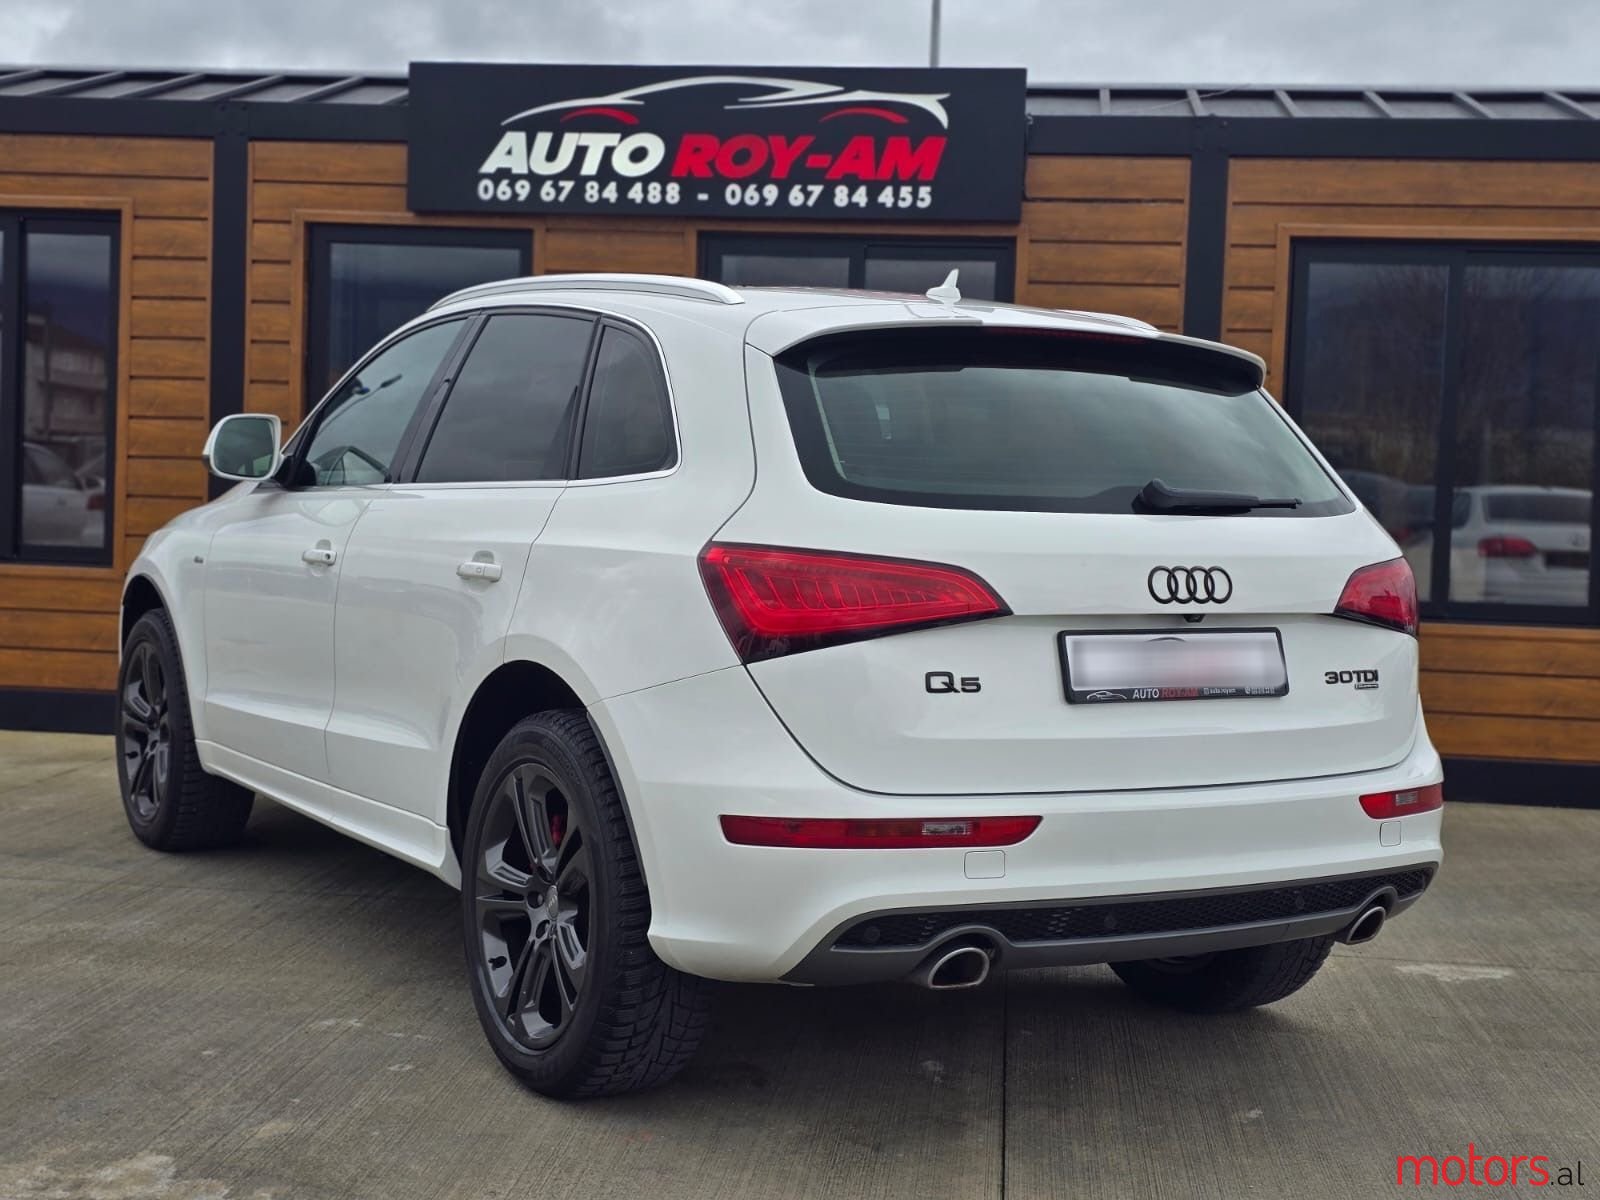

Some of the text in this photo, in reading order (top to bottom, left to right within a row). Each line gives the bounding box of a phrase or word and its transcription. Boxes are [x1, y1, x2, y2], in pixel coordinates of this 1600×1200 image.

[479, 131, 946, 182] AUTO ROY-AM
[478, 178, 529, 203] 069
[540, 179, 573, 203] 67
[585, 180, 619, 204] 84
[627, 181, 681, 206] 488
[724, 183, 779, 207] 069
[788, 184, 825, 208] 67
[833, 185, 869, 208] 84
[877, 185, 932, 209] 455
[925, 671, 982, 694] Q5
[1132, 688, 1160, 700] AUTO
